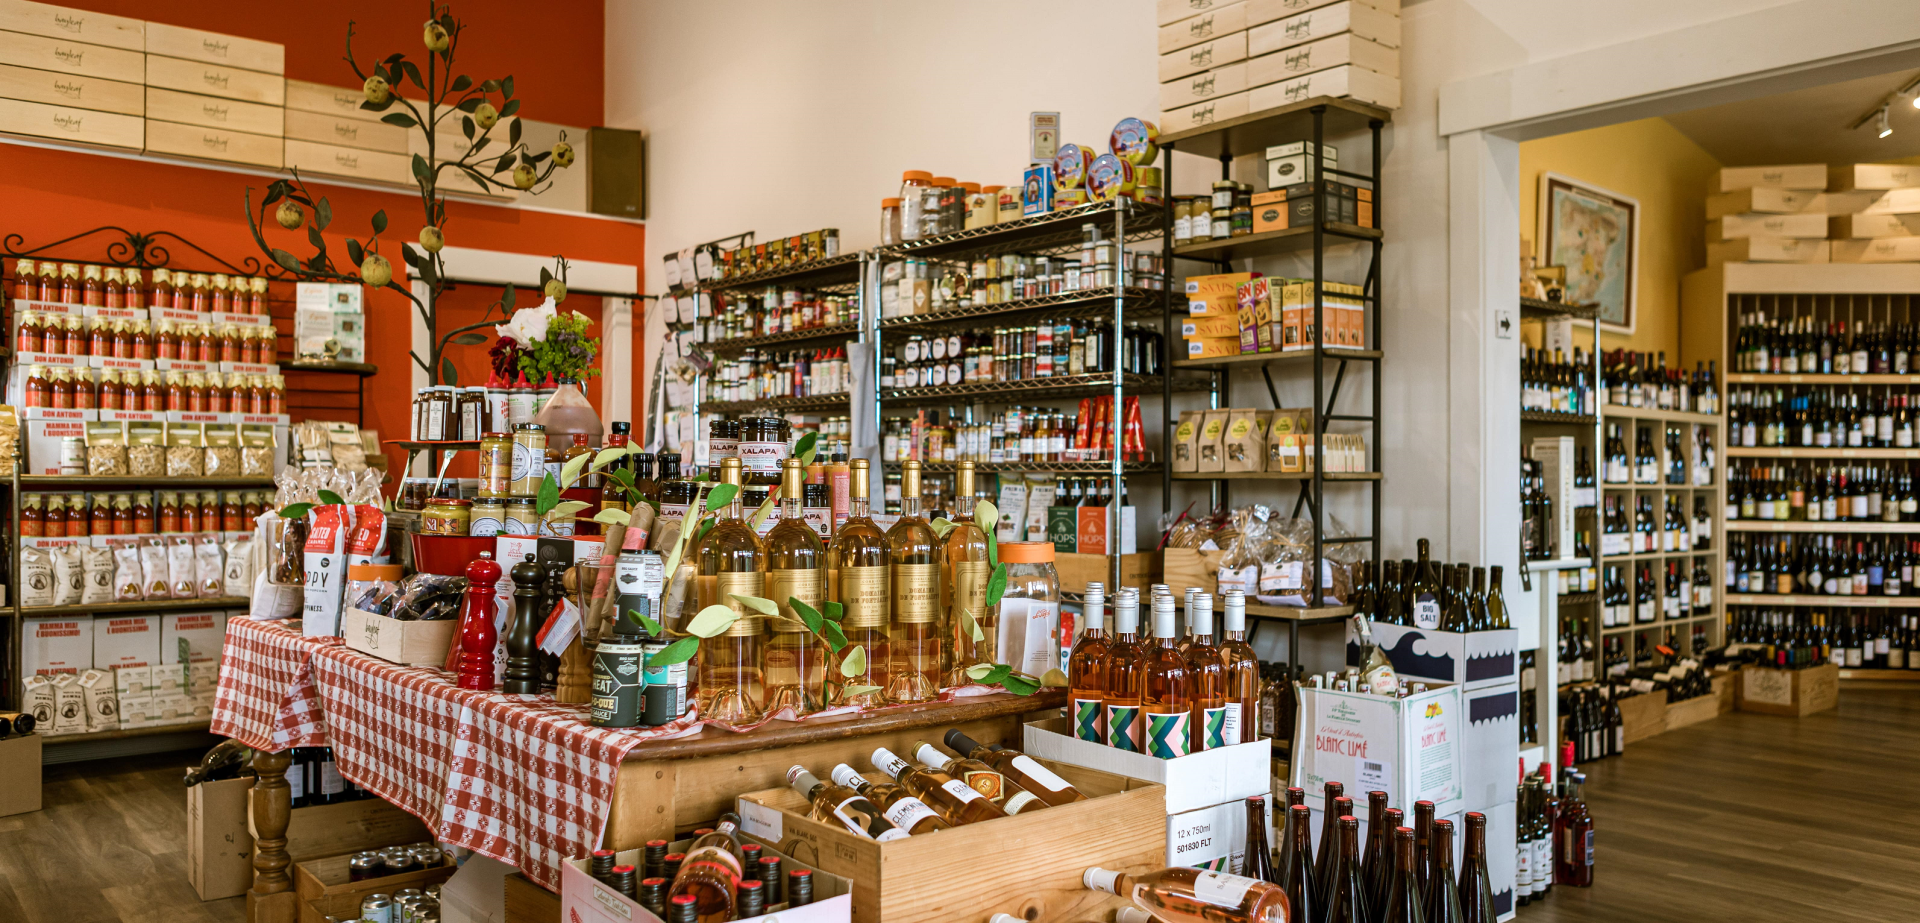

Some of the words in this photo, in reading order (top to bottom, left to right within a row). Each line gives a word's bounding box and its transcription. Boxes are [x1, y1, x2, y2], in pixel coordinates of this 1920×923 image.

[1238, 281, 1252, 303] BN
[1254, 277, 1269, 300] BN
[30, 303, 42, 312] DON
[43, 304, 69, 313] ANTONIO
[110, 309, 134, 317] ANTONIO
[175, 311, 198, 320] ANTONIO
[34, 355, 46, 363] DON
[48, 356, 74, 364] ANTONIO
[116, 360, 141, 368] ANTONIO
[310, 526, 331, 540] SALTED
[1049, 533, 1076, 544] HOPS
[1080, 534, 1105, 545] HOPS
[1422, 604, 1434, 613] BIG
[109, 619, 132, 627] MAMMA
[133, 617, 147, 626] MIA!
[1420, 613, 1436, 623] SALT
[39, 622, 61, 630] MAMMA
[62, 621, 78, 629] MIA!
[111, 624, 149, 634] BUONISSIMO!
[179, 621, 215, 631] BUONISSIMO!
[40, 629, 81, 637] BUONISSIMO!
[1421, 732, 1436, 748] BLANC
[1316, 734, 1345, 755] BLANC
[1347, 740, 1368, 759] LIMÉ
[1177, 829, 1185, 839] 12
[1192, 823, 1211, 836] 750ml
[1177, 840, 1200, 854] 501830
[1200, 837, 1212, 848] FLT
